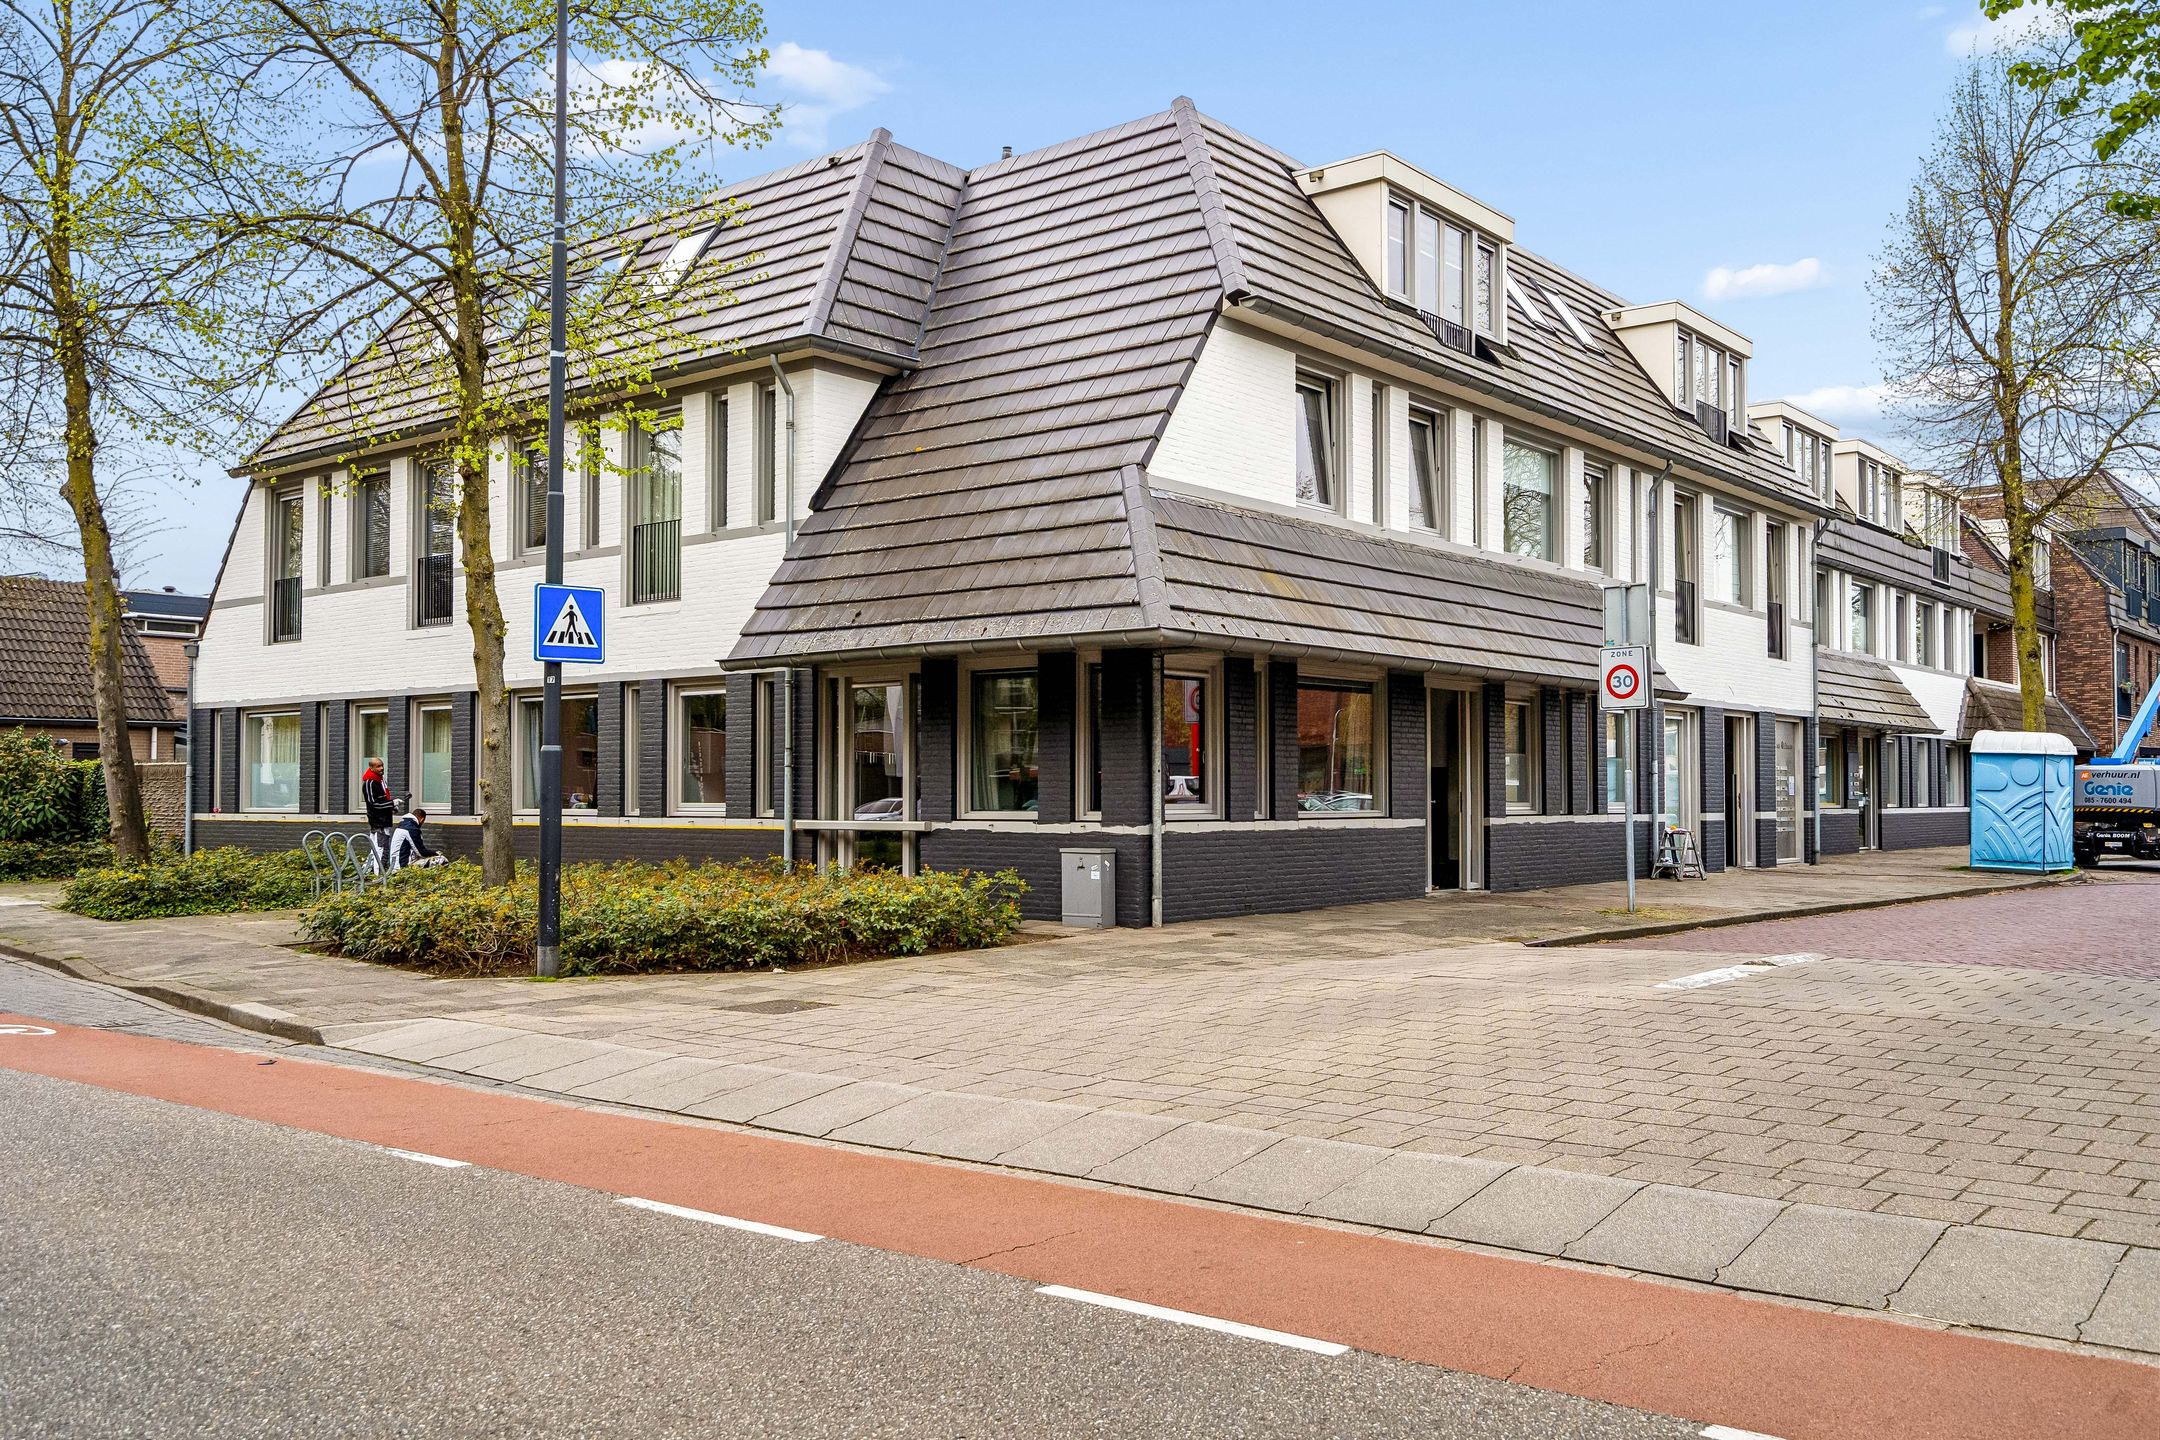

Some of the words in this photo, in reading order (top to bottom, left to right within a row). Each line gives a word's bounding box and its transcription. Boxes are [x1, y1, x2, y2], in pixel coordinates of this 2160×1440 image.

[1610, 650, 1633, 658] ZONE
[1612, 674, 1633, 688] 30
[2091, 771, 2141, 779] verhuur.nl
[2084, 780, 2134, 796] Genie
